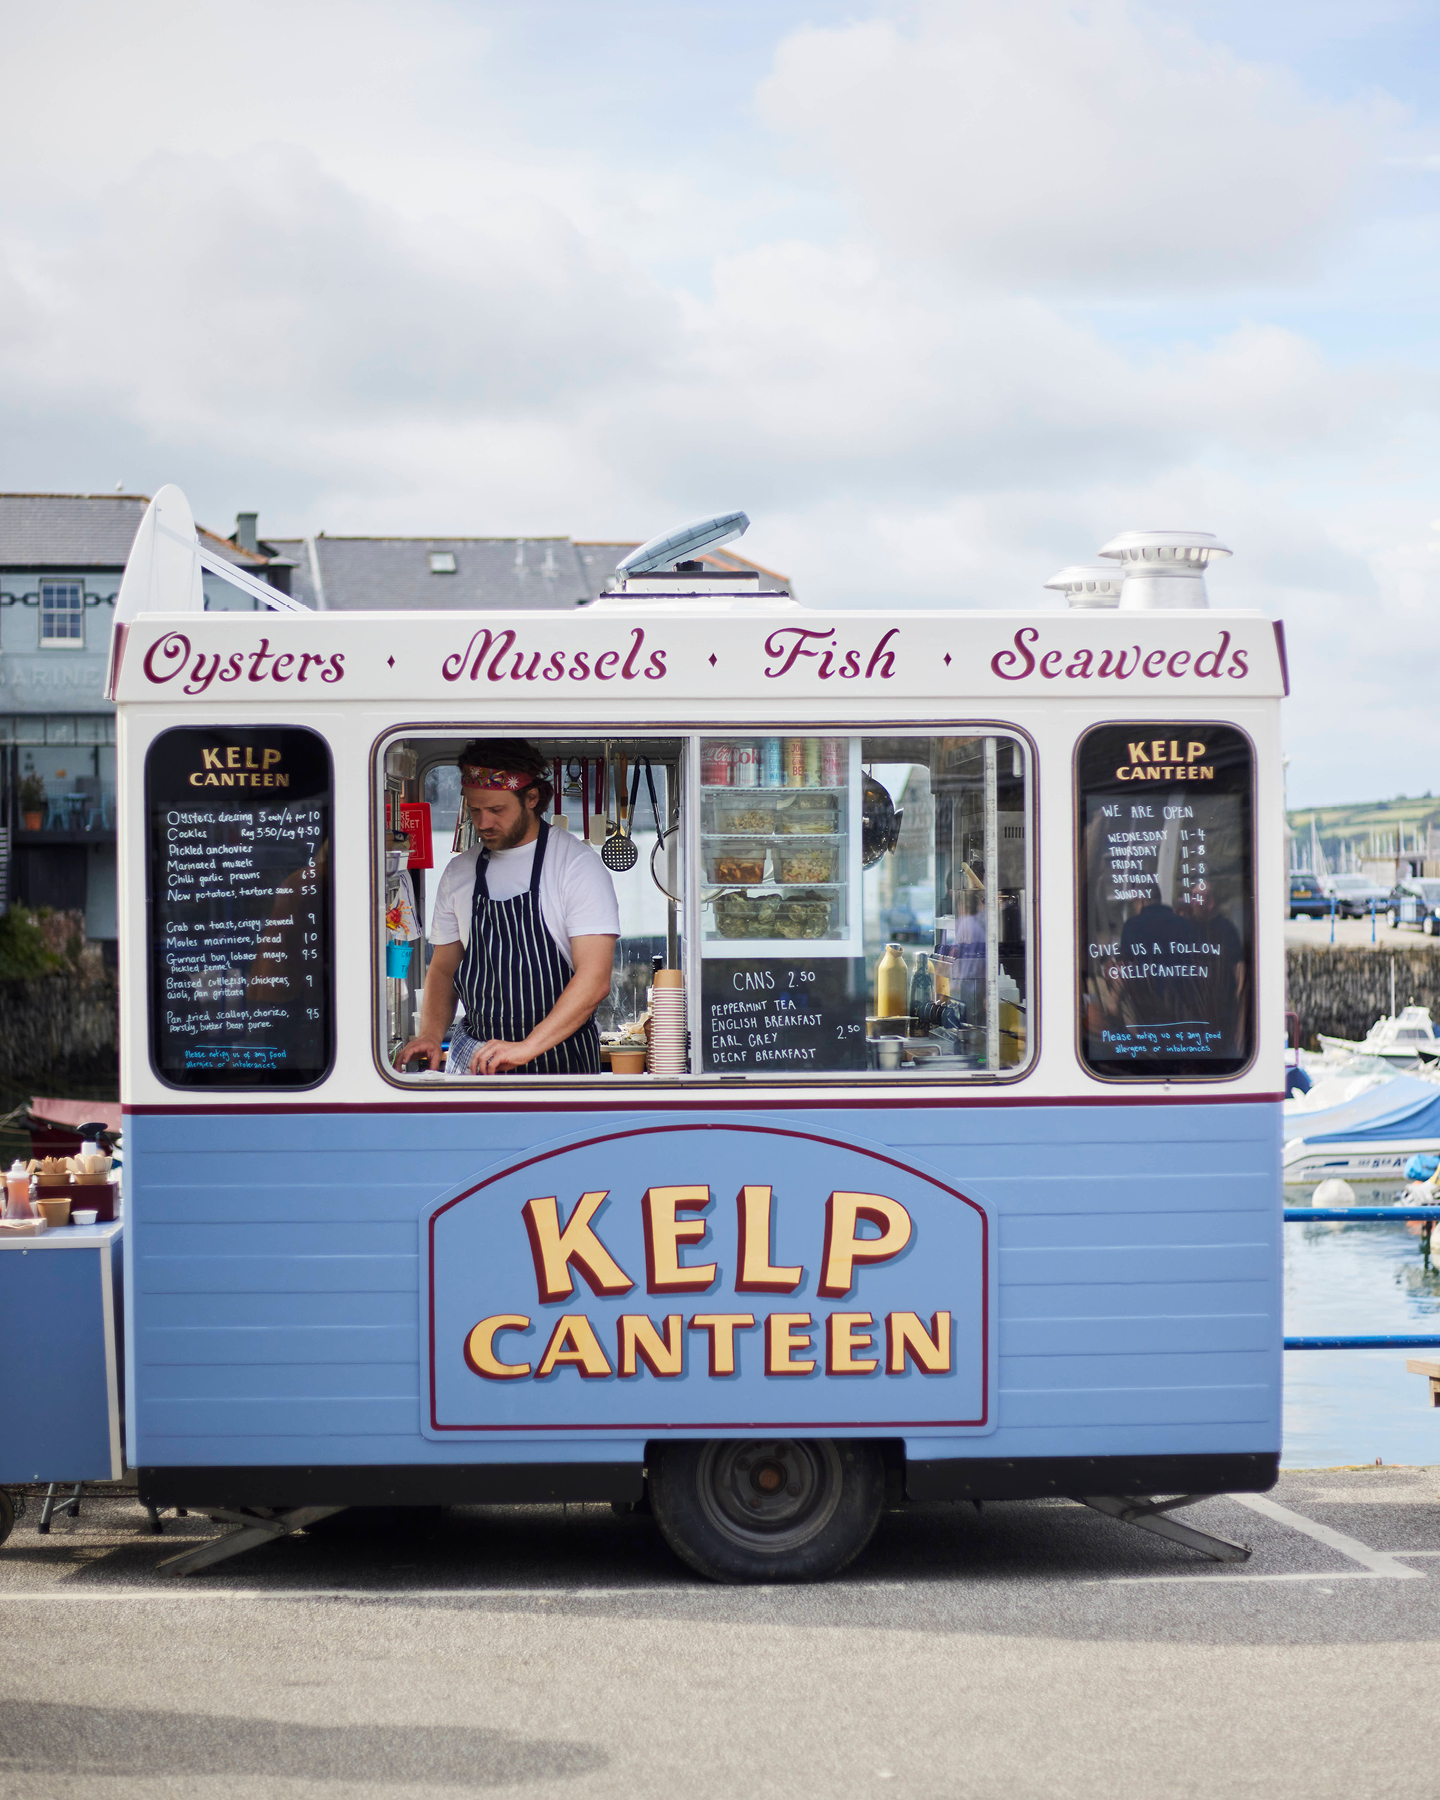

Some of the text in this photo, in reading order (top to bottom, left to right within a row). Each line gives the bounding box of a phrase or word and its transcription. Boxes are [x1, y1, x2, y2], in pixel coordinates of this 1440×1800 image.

[442, 628, 667, 682] Mussels
[764, 627, 900, 680] Fish
[990, 627, 1249, 681] Seaweeds
[143, 631, 345, 695] Oysters
[202, 747, 282, 770] KELP
[1127, 740, 1206, 764] KELP
[189, 773, 289, 787] CANTEEN
[1115, 766, 1214, 780] CANTEEN
[218, 811, 253, 826] dressing
[258, 811, 266, 823] 3
[308, 810, 320, 823] 10
[1102, 805, 1194, 820] WE ARE OPEN
[167, 827, 208, 841] Cockles
[241, 828, 254, 841] Reg
[1107, 830, 1168, 843] WEDNESDAY
[169, 842, 315, 857] Pickled anchovies 7
[1109, 845, 1157, 857] THURSDAY
[167, 857, 316, 873] Marinated mussels 6
[1111, 859, 1144, 870] FRIDAY
[168, 873, 195, 887] Chilli
[199, 872, 224, 887] garlic
[229, 871, 261, 885] prawns
[1112, 873, 1159, 885] SATURDAY
[167, 889, 191, 902] New
[238, 885, 274, 896] tartare
[275, 886, 294, 895] sauce
[1114, 888, 1152, 900] SUNDAY
[166, 921, 189, 934] Crab
[194, 924, 206, 932] on
[237, 918, 262, 932] crispy
[264, 914, 294, 926] seaweed
[308, 912, 316, 925] 9
[166, 936, 198, 949] Moules
[256, 932, 282, 944] bread
[303, 932, 318, 945] 10
[1089, 941, 1221, 959] GIVE US A FOLLOW
[166, 953, 206, 966] Gurnard
[170, 964, 200, 974] pickled
[1108, 963, 1209, 979] @KELPCANTEEN
[166, 977, 203, 990] Braised
[305, 974, 313, 987] 9
[733, 970, 775, 991] CANS
[193, 991, 208, 1000] pan
[711, 1000, 796, 1016] PEPPERMINT TEA
[166, 1010, 182, 1024] Pan
[185, 1010, 211, 1025] fried
[711, 1014, 822, 1032] ENGLISH BREAKFAST
[200, 1021, 223, 1031] butter
[712, 1032, 778, 1048] EARL GREY
[1102, 1030, 1132, 1042] Please
[1136, 1031, 1157, 1043] notify
[1175, 1032, 1184, 1041] of
[1187, 1033, 1201, 1045] any
[1205, 1031, 1222, 1040] food
[185, 1050, 206, 1058] Please
[209, 1049, 230, 1062] notify
[243, 1051, 251, 1060] of
[269, 1049, 287, 1060] food
[712, 1048, 816, 1063] DECAF BREAKFAST
[521, 1184, 918, 1305] KELP
[463, 1311, 952, 1380] CANTEEN
